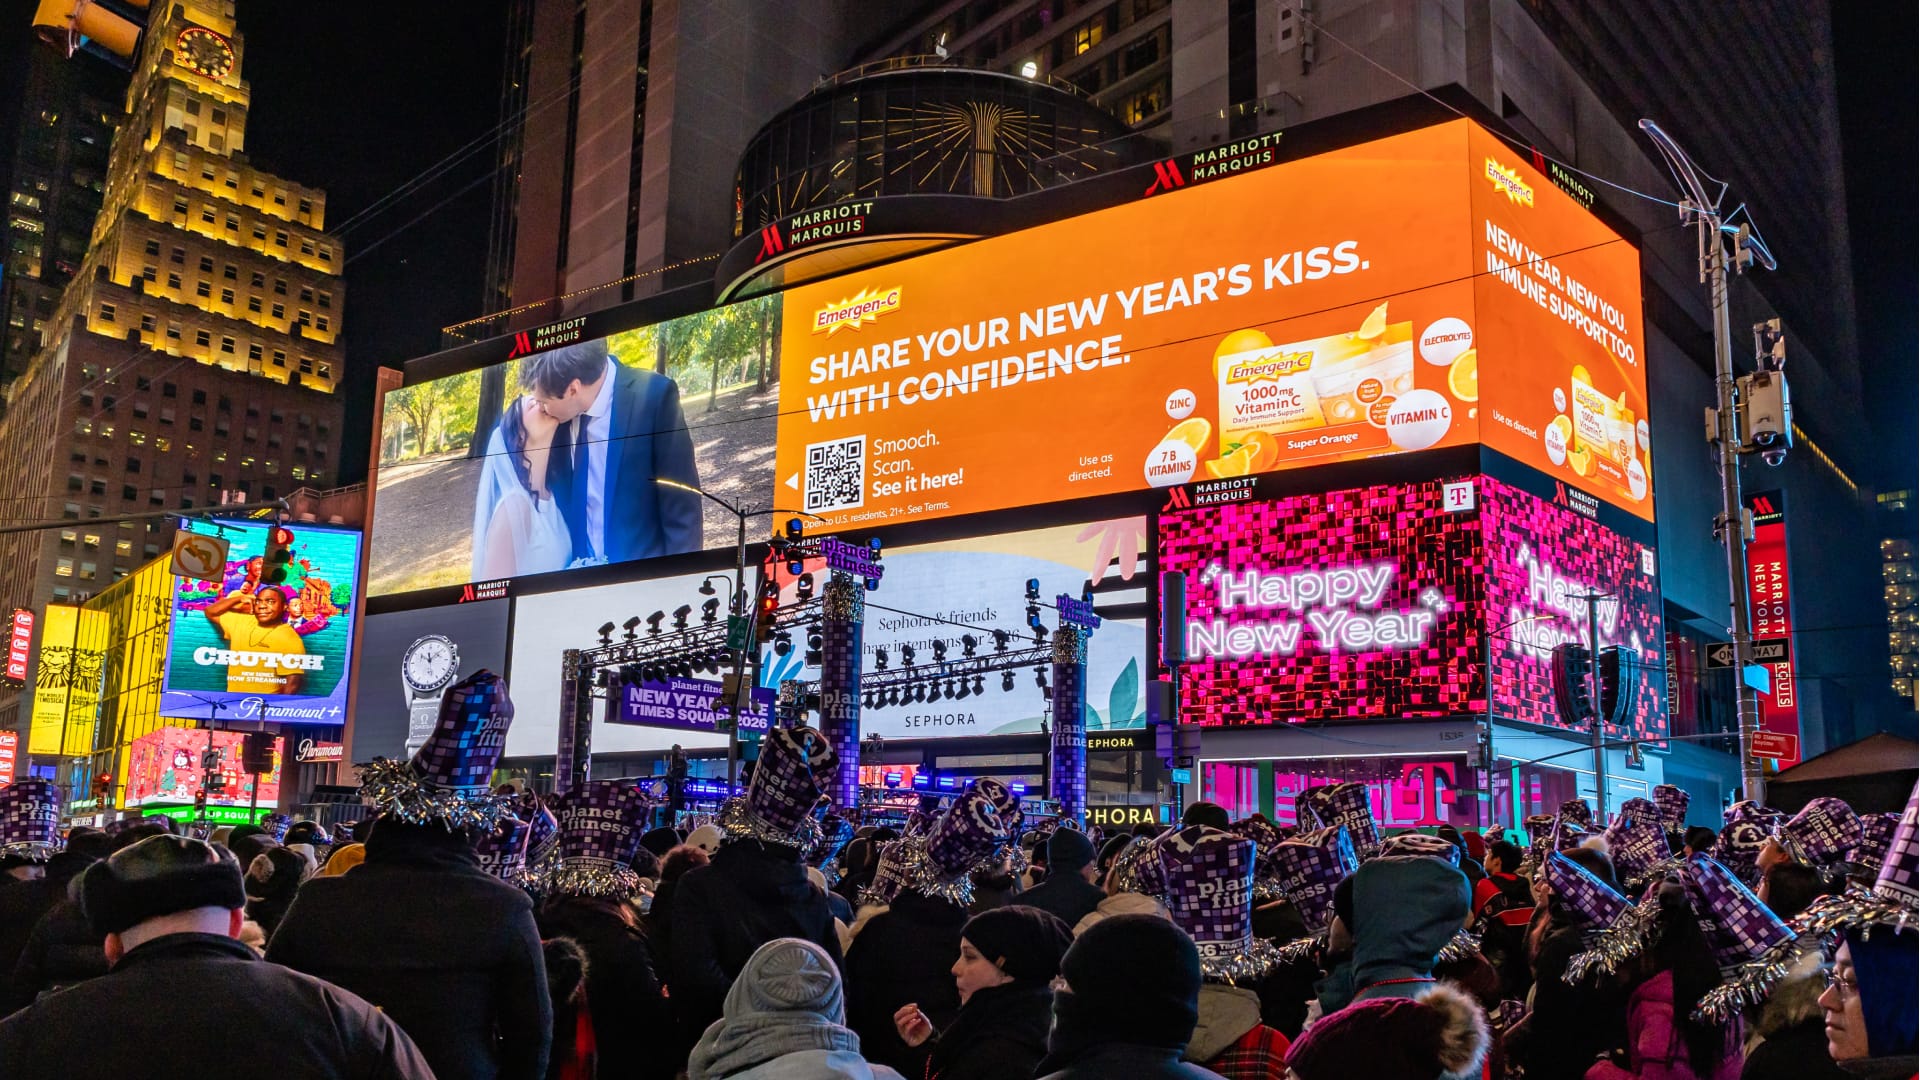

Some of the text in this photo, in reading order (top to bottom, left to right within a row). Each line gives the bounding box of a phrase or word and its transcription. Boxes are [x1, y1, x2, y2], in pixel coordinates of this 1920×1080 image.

[1194, 132, 1283, 165] MARRIOTT
[1194, 151, 1272, 180] MARQUIS
[1487, 162, 1532, 203] Emergen-C
[1551, 163, 1594, 204] MARRIOTT
[791, 202, 873, 230] MARRIOTT
[790, 218, 862, 246] MARQUIS
[1485, 219, 1627, 334] NEW YEAR. NEW YOU.
[809, 240, 1370, 384] SHARE YOUR NEW YEAR'S KISS.
[816, 290, 899, 326] Emergen-C
[1486, 250, 1637, 367] IMMUNE SUPPORT TOO.
[536, 316, 587, 338] MARRIOTT
[535, 329, 580, 350] MARQUIS
[1424, 331, 1471, 347] ELECTROLYTES
[806, 333, 1132, 423] WITH CONFIDENCE.
[1232, 354, 1309, 380] Emergen-C
[1279, 387, 1294, 397] mg
[1169, 398, 1191, 410] ZINC
[1235, 394, 1301, 416] Vitamin C
[1390, 409, 1438, 427] VITAMIN
[1441, 407, 1449, 419] C
[1492, 409, 1505, 424] Use
[873, 429, 940, 457] Smooch.
[1287, 432, 1359, 451] Super Orange
[872, 455, 914, 478] Scan.
[1079, 454, 1113, 467] Use as
[1161, 450, 1177, 462] 7 B
[1067, 467, 1112, 483] directed.
[1148, 460, 1191, 477] VITAMINS
[872, 468, 964, 498] See it here!
[1196, 477, 1258, 493] MARRIOTT
[1196, 489, 1251, 503] MARQUIS
[1569, 488, 1599, 509] MARRIOTT
[802, 519, 824, 530] Open
[835, 514, 849, 525] U.S.
[907, 504, 923, 514] See
[1569, 499, 1597, 518] MARQUIS
[1753, 512, 1783, 521] MARRIOTT
[821, 537, 873, 560] planet
[829, 552, 883, 580] fitness
[477, 580, 511, 591] MARRIOTT
[477, 589, 506, 599] MARQUIS
[1222, 563, 1391, 609] Happy
[1754, 564, 1769, 635] NEW YORK
[878, 607, 997, 633] Sephora & friends
[863, 628, 1020, 655] hare 226
[1189, 607, 1432, 659] New Year
[1770, 561, 1791, 705] MARRIOTT RQUIS
[193, 646, 325, 671] CRUTCH
[246, 676, 288, 685] STREAMING
[671, 680, 724, 694] planet fitne
[630, 688, 670, 707] NEW
[630, 703, 676, 721] TIMES
[905, 712, 976, 728] SEPHORA
[1088, 737, 1135, 749] EPHORA
[1402, 761, 1457, 826] T
[223, 810, 263, 819] SQUAE
[561, 805, 623, 822] planet
[1085, 808, 1155, 826] PHORA
[1806, 805, 1844, 841] planet
[567, 817, 632, 836] fitness
[1806, 812, 1838, 854] fitness
[1619, 834, 1654, 861] planet
[1628, 838, 1663, 862] fitness
